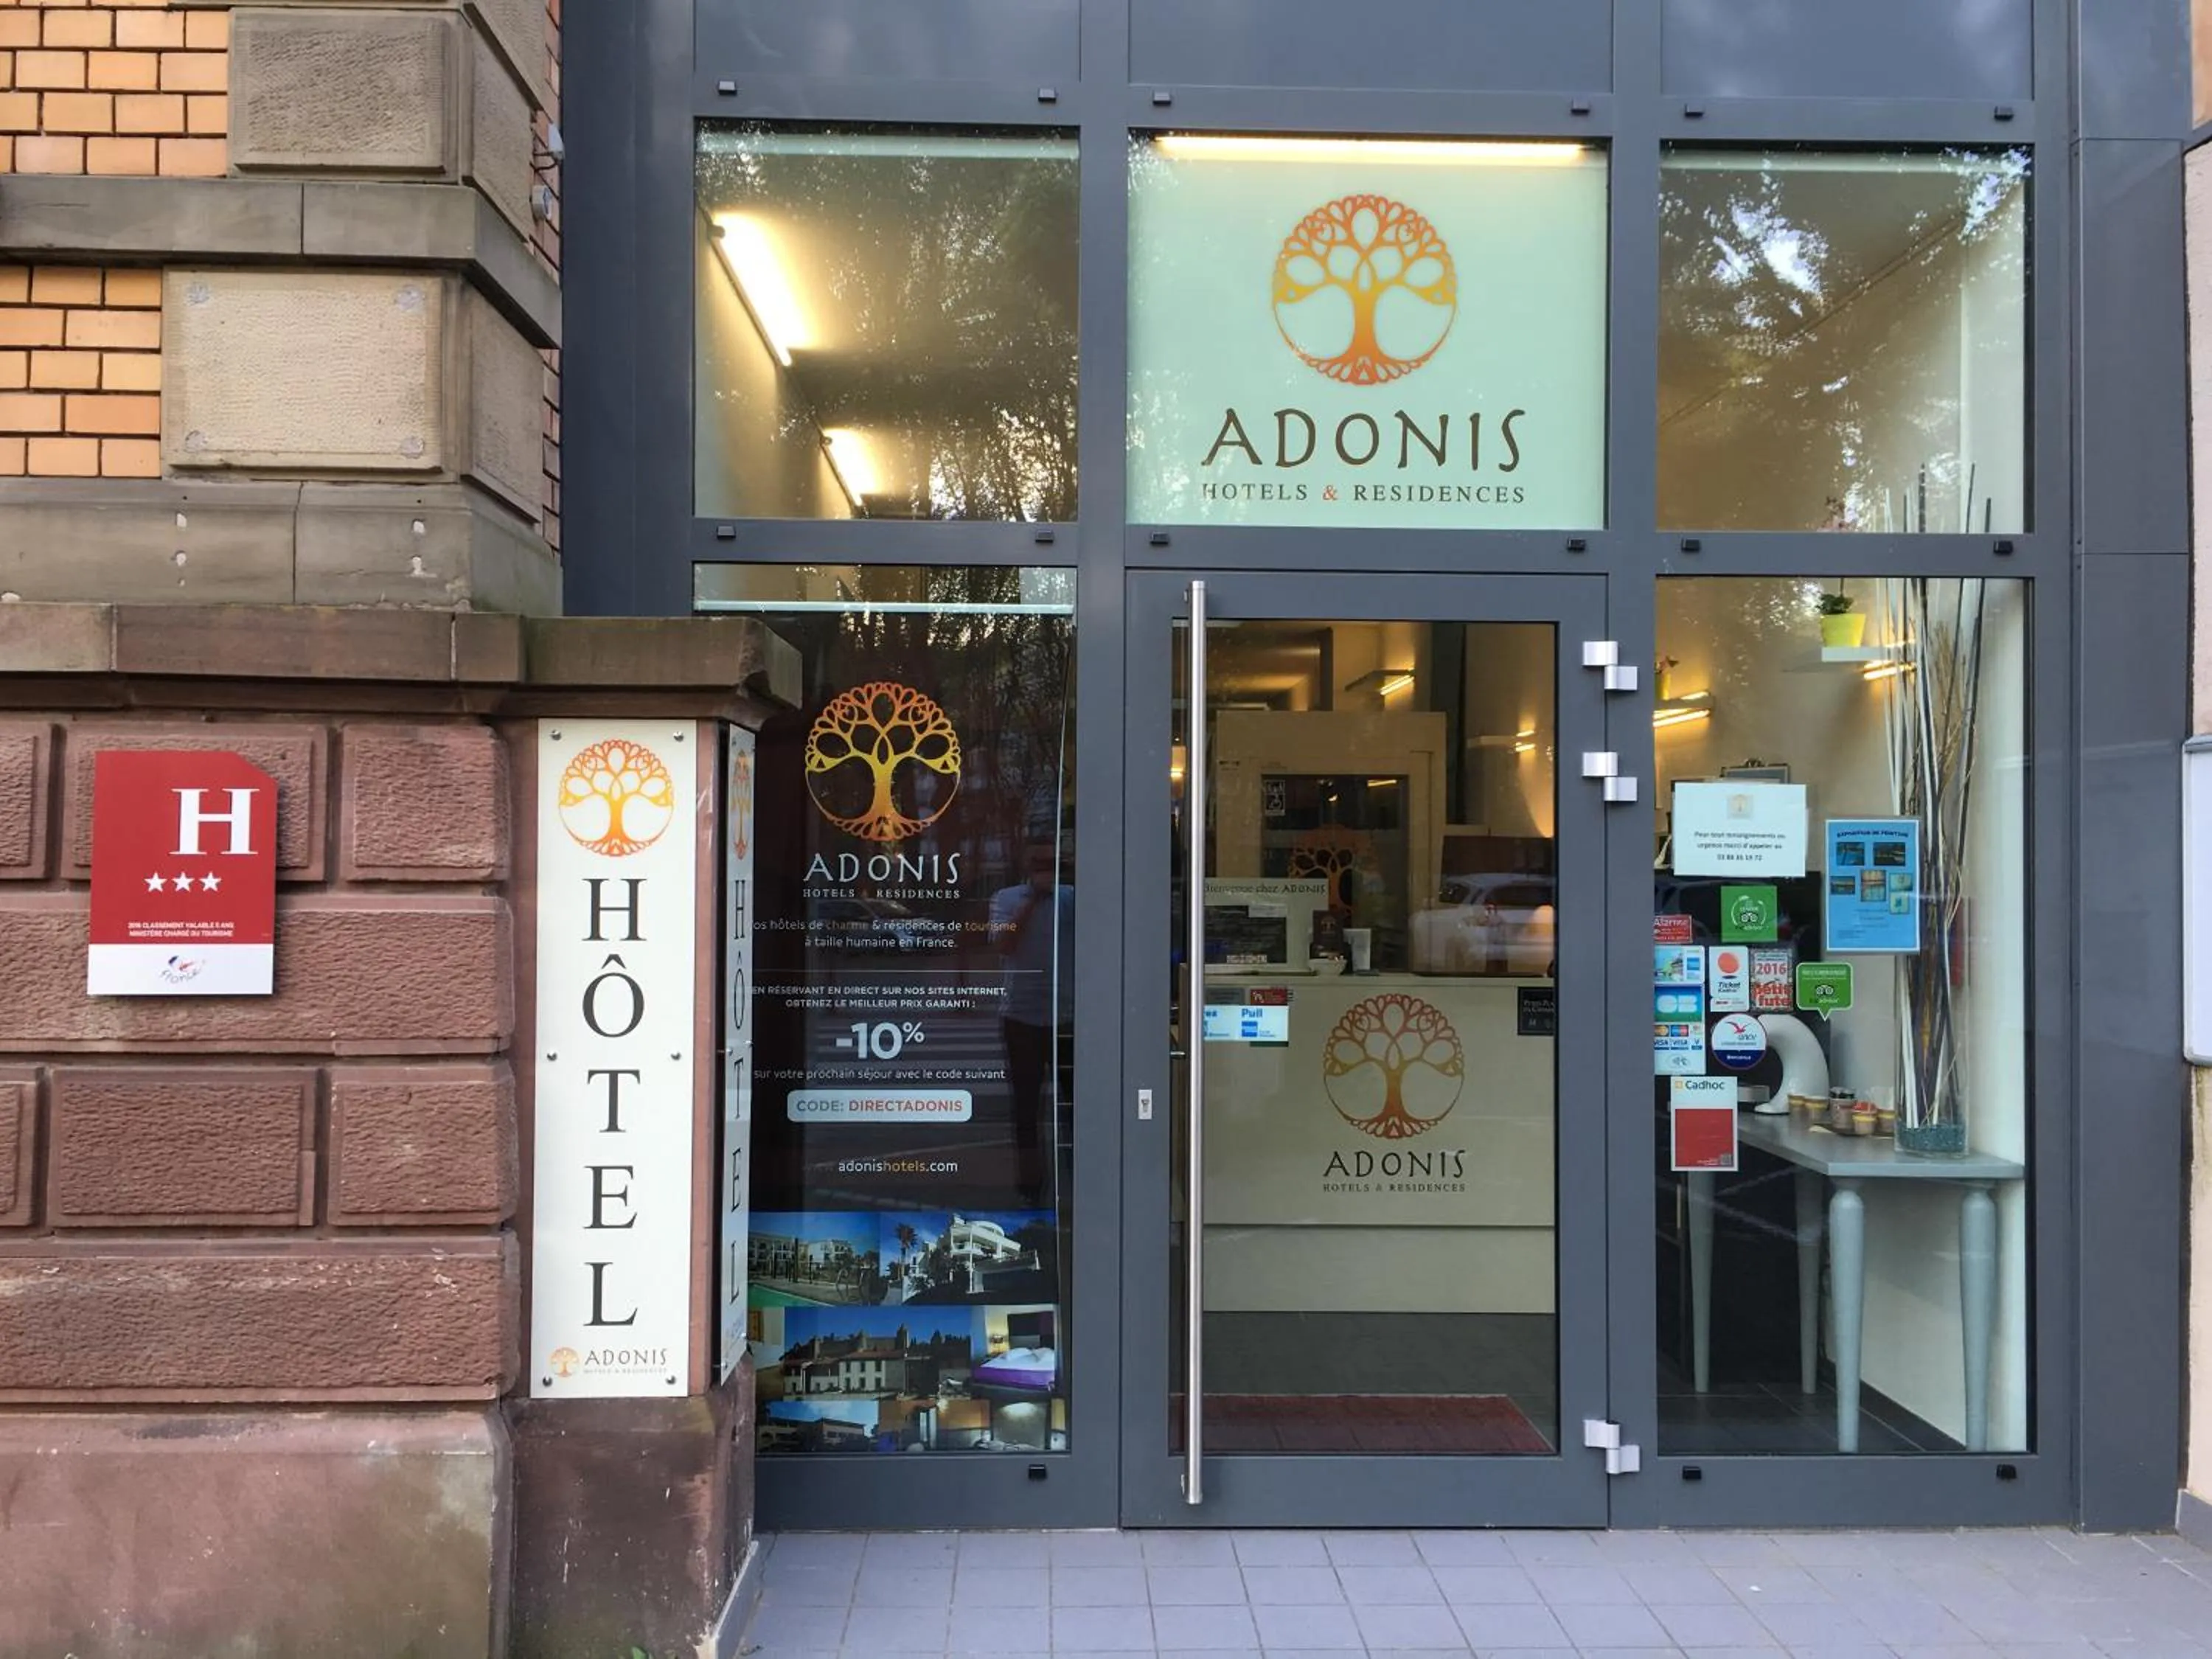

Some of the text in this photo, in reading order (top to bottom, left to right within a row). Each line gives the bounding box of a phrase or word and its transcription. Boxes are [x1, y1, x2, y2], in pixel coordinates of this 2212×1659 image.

[1201, 408, 1526, 472] ADONIS
[1201, 483, 1526, 503] HOTELS & RESIDENCES
[169, 787, 260, 855] H
[803, 852, 961, 883] ADONIS
[803, 888, 855, 898] HOTELS
[876, 888, 961, 900] RESIDENCES
[769, 919, 805, 931] hôtels
[807, 921, 823, 931] de
[947, 921, 962, 931] de
[964, 922, 1018, 932] tourisme
[814, 936, 844, 947] taille
[846, 936, 896, 947] humaine
[899, 939, 914, 947] en
[1756, 962, 1787, 975] 2016
[827, 987, 842, 995] EN
[844, 987, 880, 995] DIRECT
[882, 987, 902, 995] SUR
[904, 987, 925, 995] NOS
[834, 999, 847, 1008] LE
[849, 999, 897, 1008] MEILLEUR
[900, 999, 923, 1008] PRIX
[1241, 1008, 1263, 1018] Pull
[835, 1021, 925, 1060] -10%
[754, 1071, 772, 1079] sur
[774, 1070, 804, 1079] votre
[806, 1068, 855, 1082] prochain
[858, 1068, 892, 1082] séjour
[895, 1071, 920, 1079] avec
[936, 1068, 962, 1079] code
[965, 1068, 1006, 1079] suivant
[1685, 1080, 1725, 1090] Cadhoc
[581, 878, 647, 1327] HÔTEL
[796, 1099, 963, 1112] CODE: DIRECTADONIS
[838, 1159, 958, 1172] adonishotels.com
[1322, 1149, 1467, 1178] ADONIS
[1323, 1183, 1370, 1192] HOTELS
[1388, 1183, 1467, 1193] RESIDENCES
[584, 1348, 667, 1366] ADONIS
